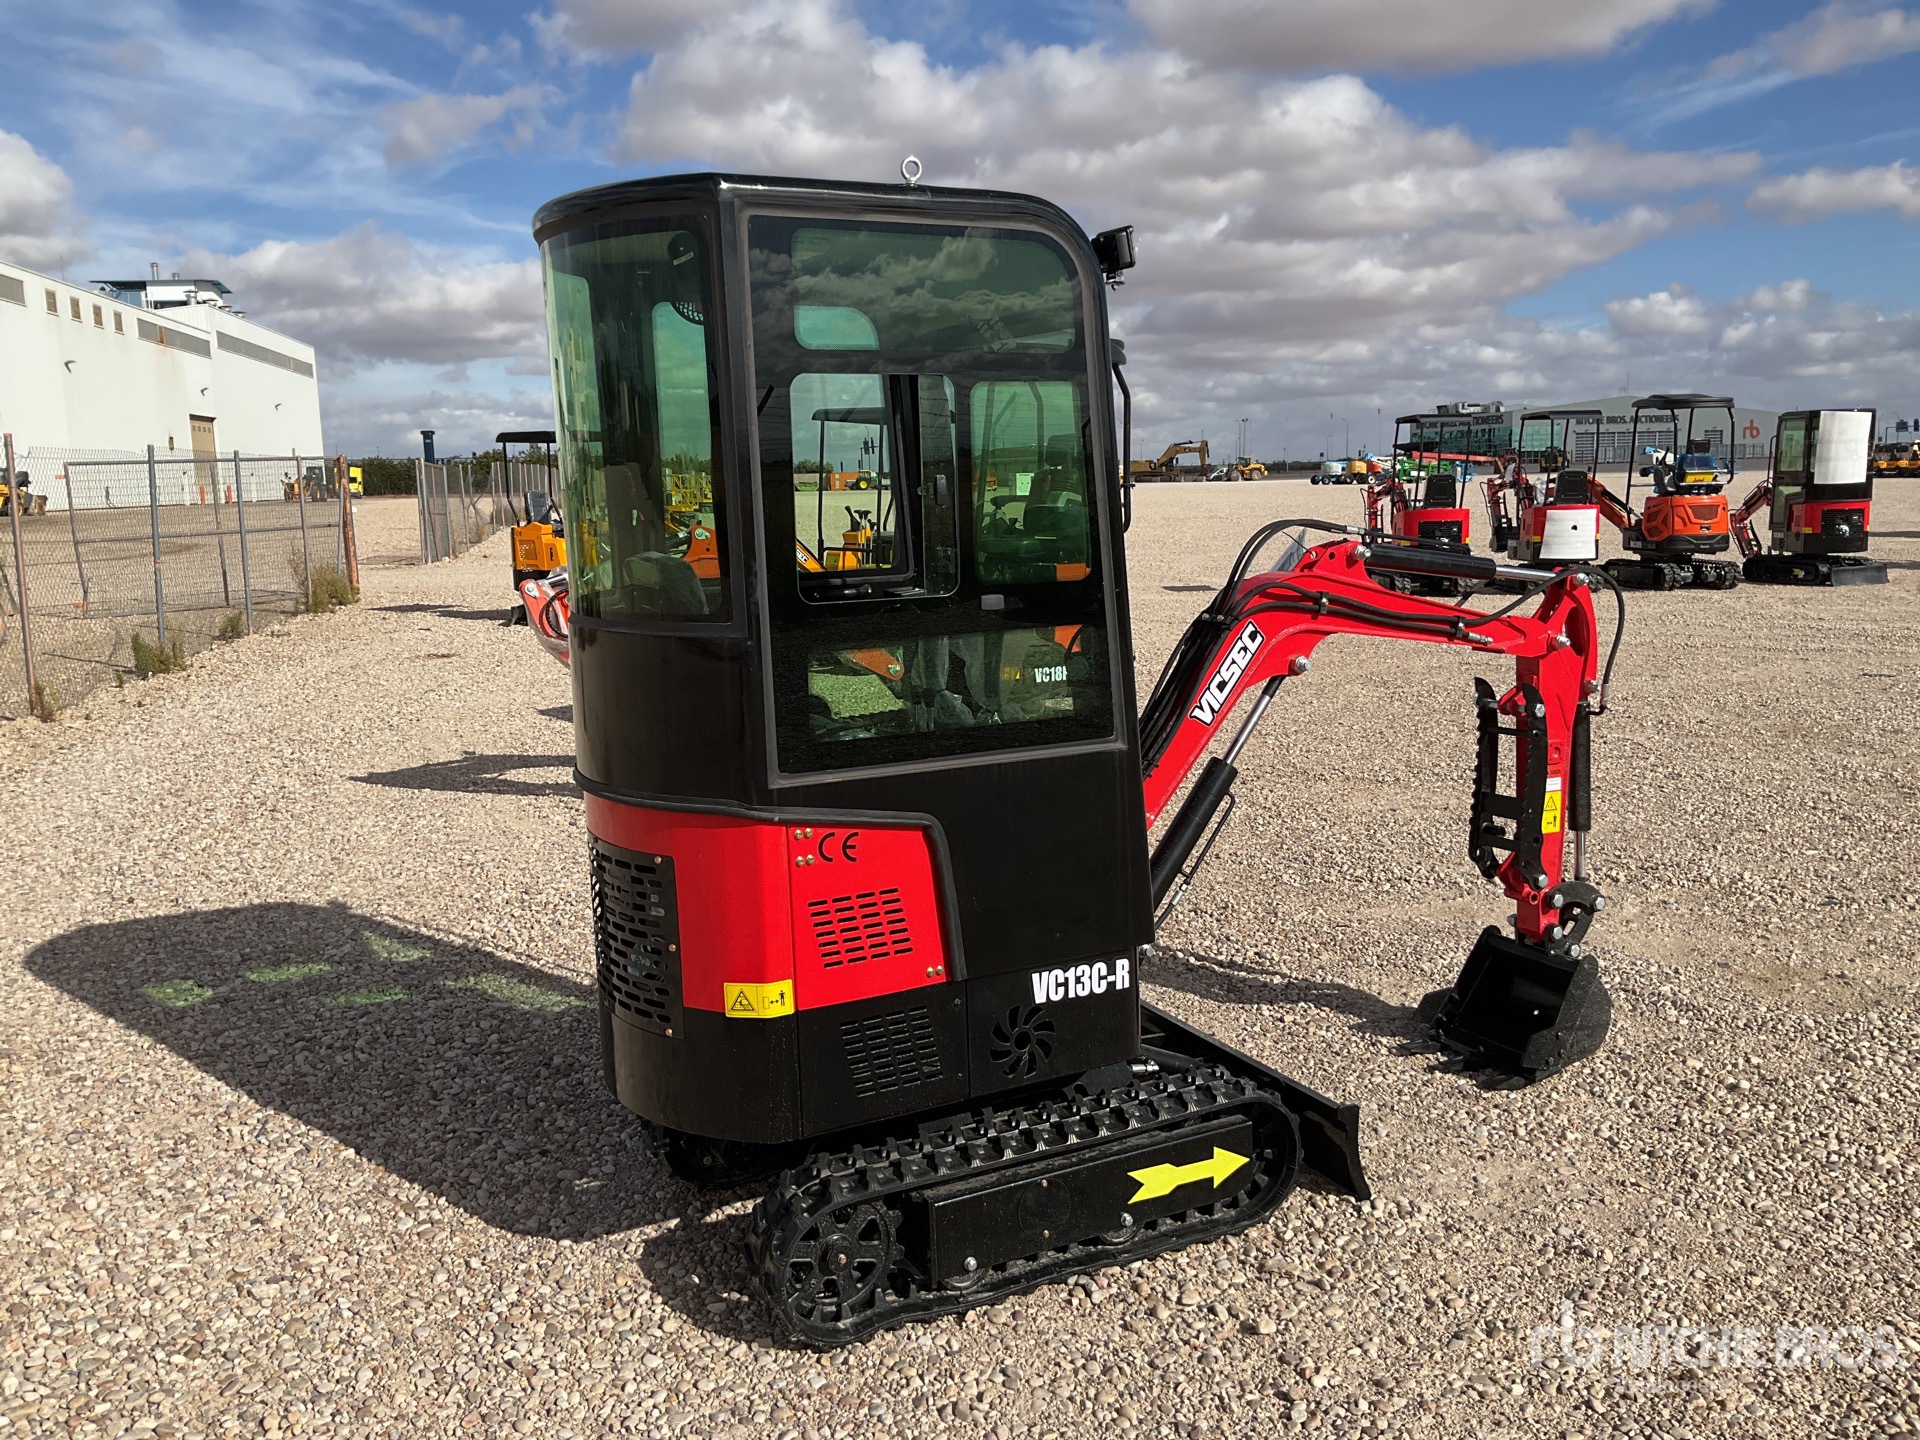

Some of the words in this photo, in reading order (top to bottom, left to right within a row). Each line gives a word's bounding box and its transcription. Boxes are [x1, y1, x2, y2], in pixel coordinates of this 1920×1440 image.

[1629, 414, 1679, 425] ACTIONEES
[1742, 419, 1760, 439] rb
[1189, 620, 1264, 726] VICSEC
[818, 832, 859, 862] CE
[1031, 958, 1130, 1004] VC13C-R
